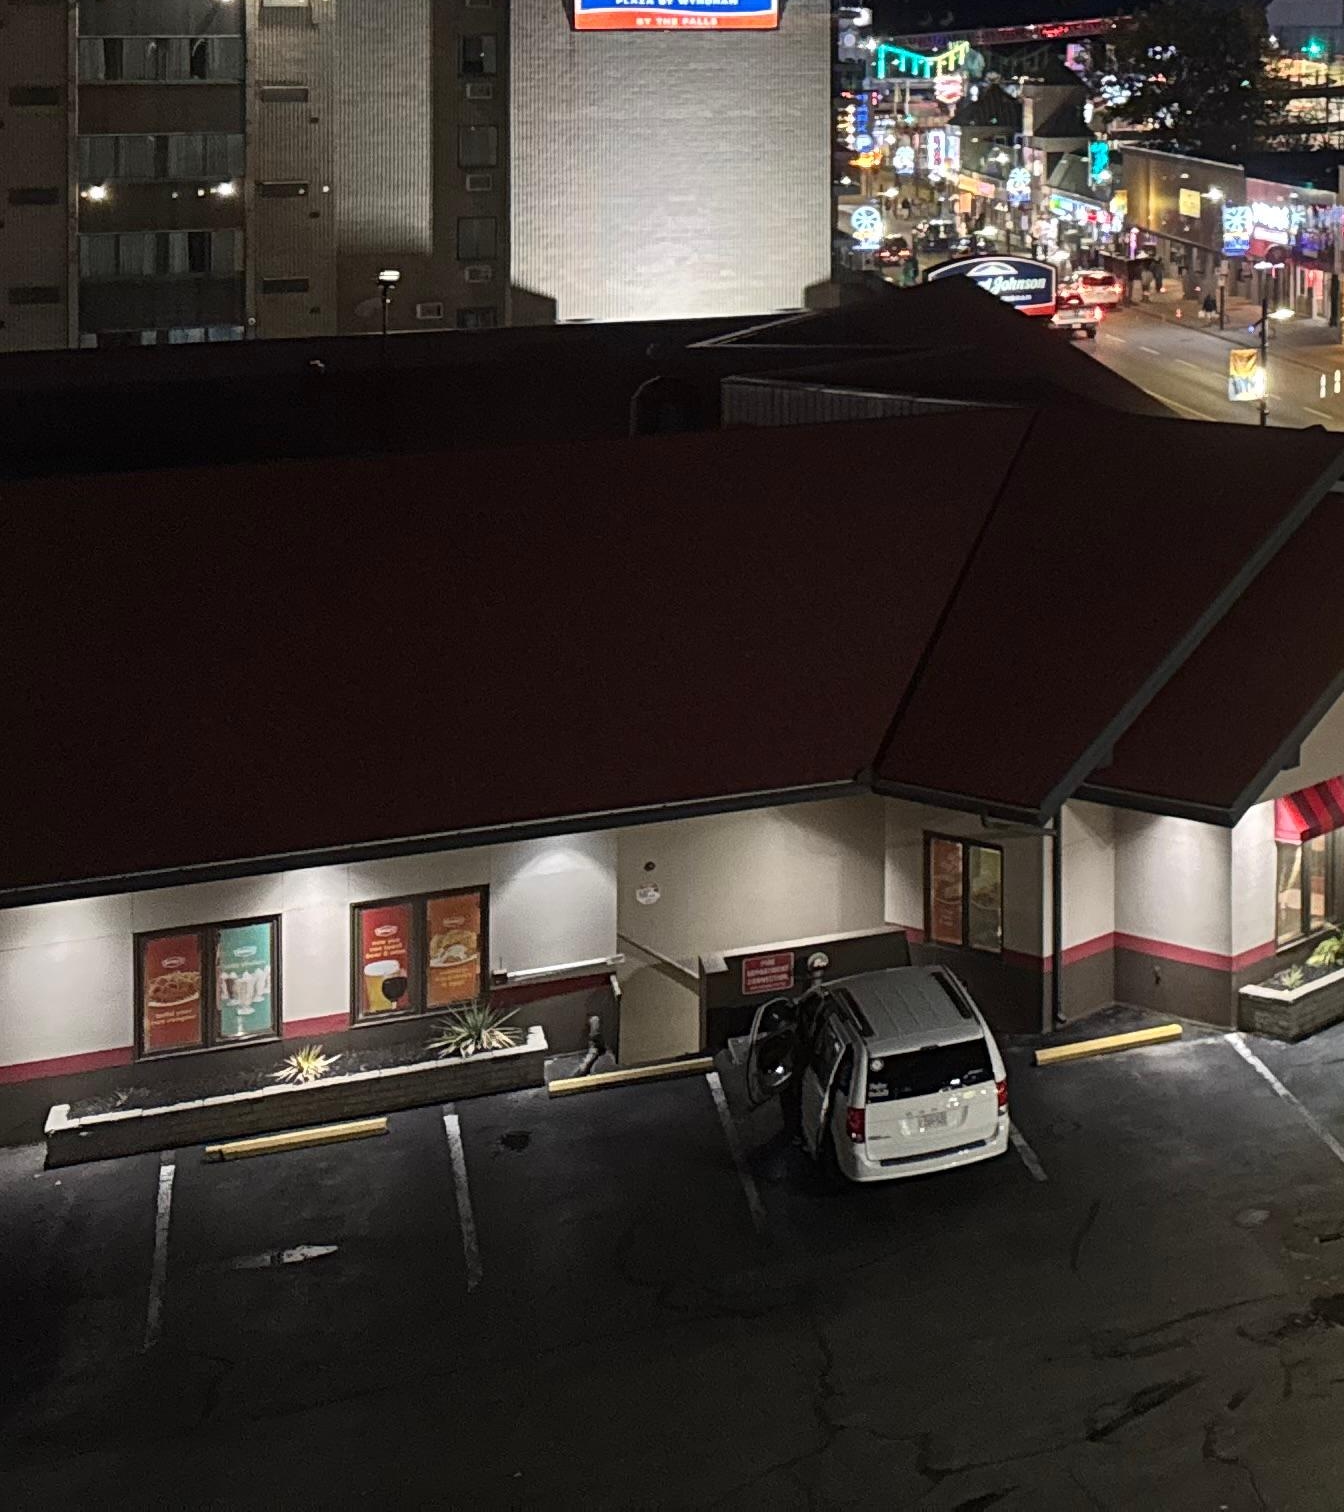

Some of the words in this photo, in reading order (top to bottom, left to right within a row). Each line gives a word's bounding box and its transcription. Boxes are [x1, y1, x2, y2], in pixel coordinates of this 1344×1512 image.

[655, 17, 678, 26] THE
[682, 17, 718, 26] FALLS
[990, 275, 1047, 295] Johnson
